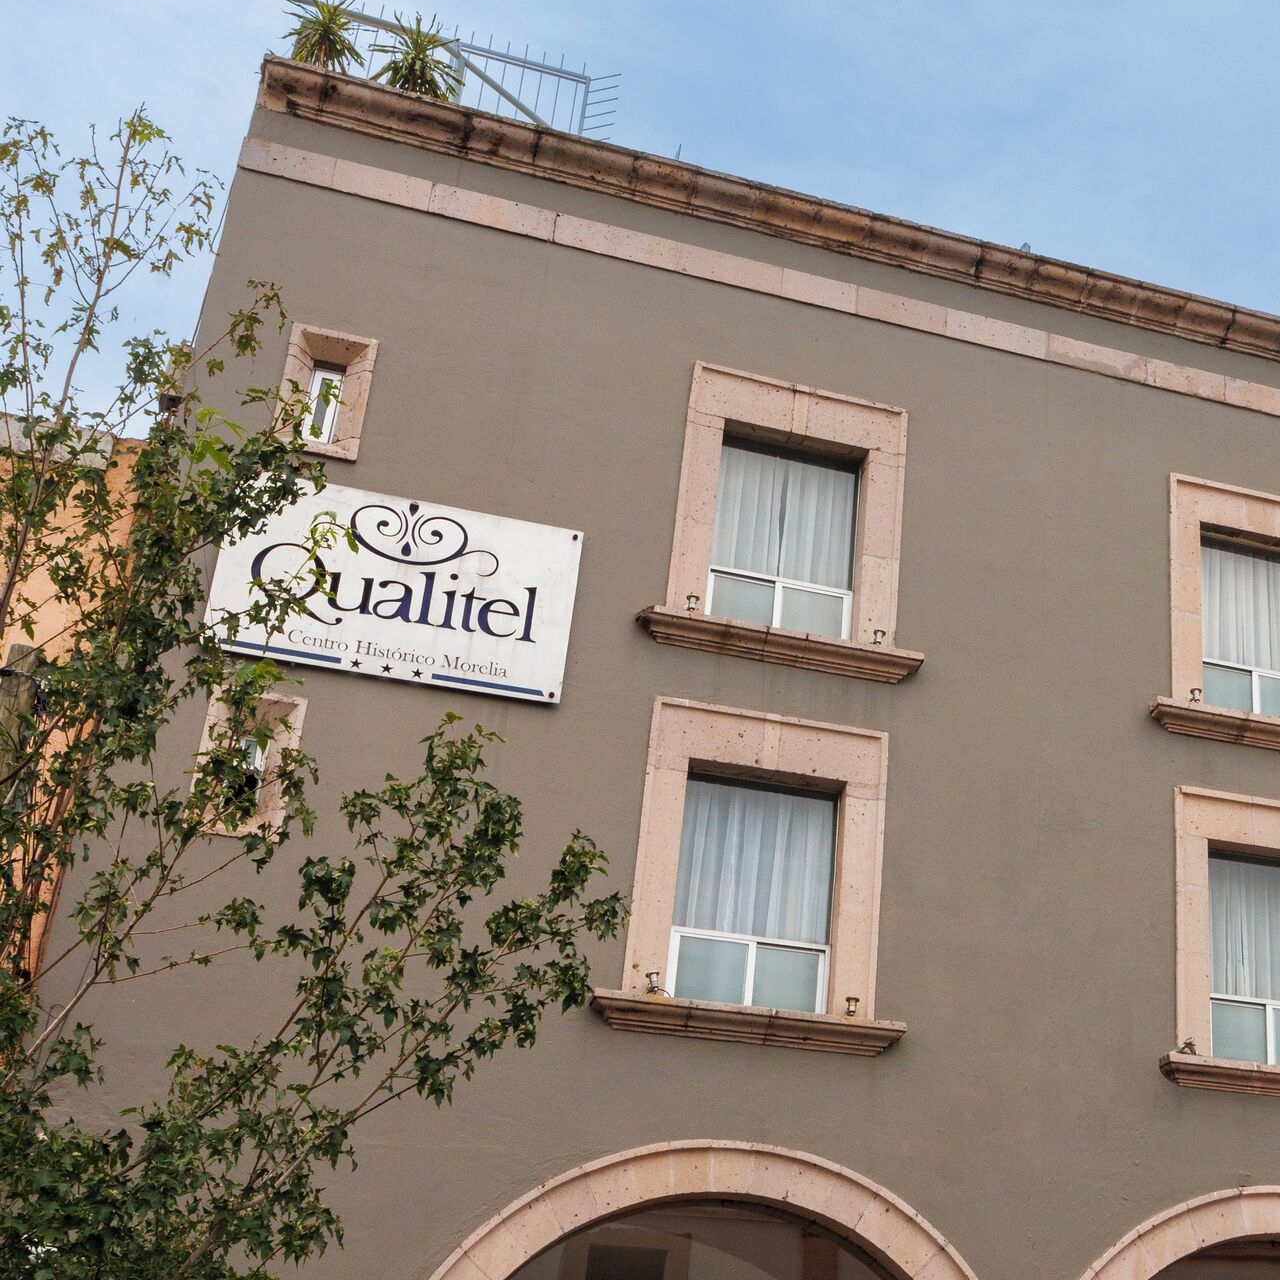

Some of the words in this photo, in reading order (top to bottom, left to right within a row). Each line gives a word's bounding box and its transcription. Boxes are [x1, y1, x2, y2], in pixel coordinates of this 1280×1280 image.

[250, 542, 537, 644] Qualitel
[287, 628, 349, 653] Centro
[355, 640, 436, 667] Histórico
[442, 654, 508, 679] Morelia
